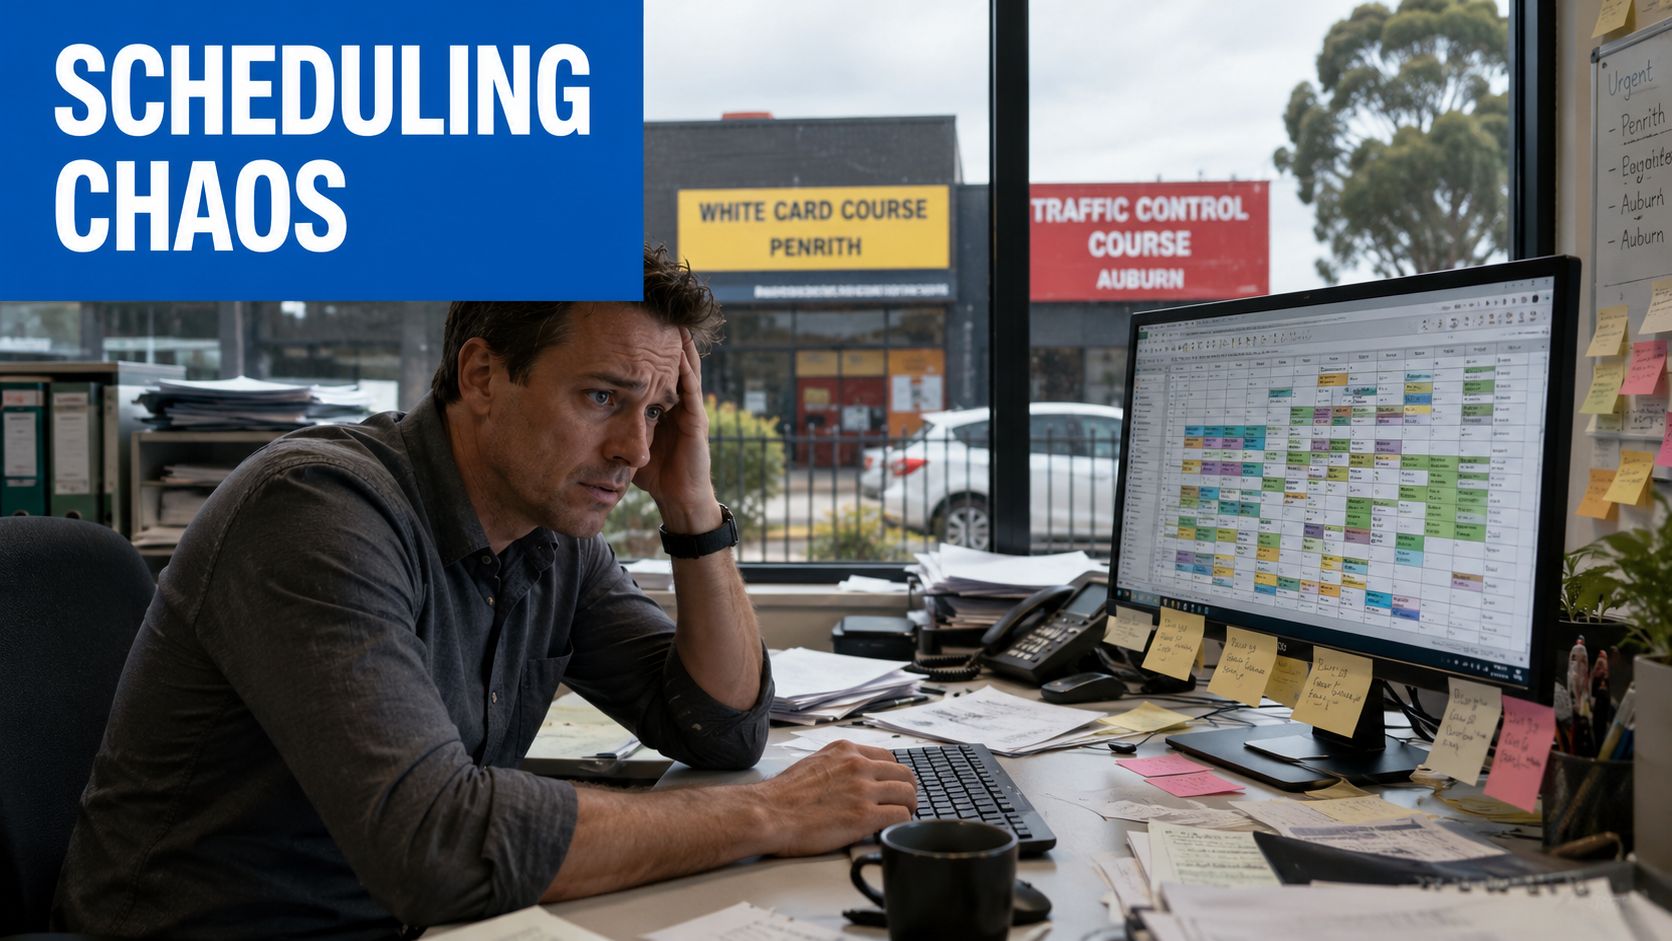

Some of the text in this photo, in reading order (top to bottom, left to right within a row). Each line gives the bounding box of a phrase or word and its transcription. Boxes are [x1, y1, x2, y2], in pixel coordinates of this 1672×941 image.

[1608, 59, 1654, 101] Urgent
[1621, 102, 1666, 137] Penrith
[699, 199, 927, 222] WHITE CARD COURSE
[1031, 195, 1249, 223] TRAFFIC CONTROL
[1620, 187, 1664, 215] Auburn
[769, 237, 862, 257] PENRITH
[1088, 230, 1192, 258] COURSE
[1620, 226, 1664, 250] Auburn
[1096, 268, 1185, 290] AUBURN
